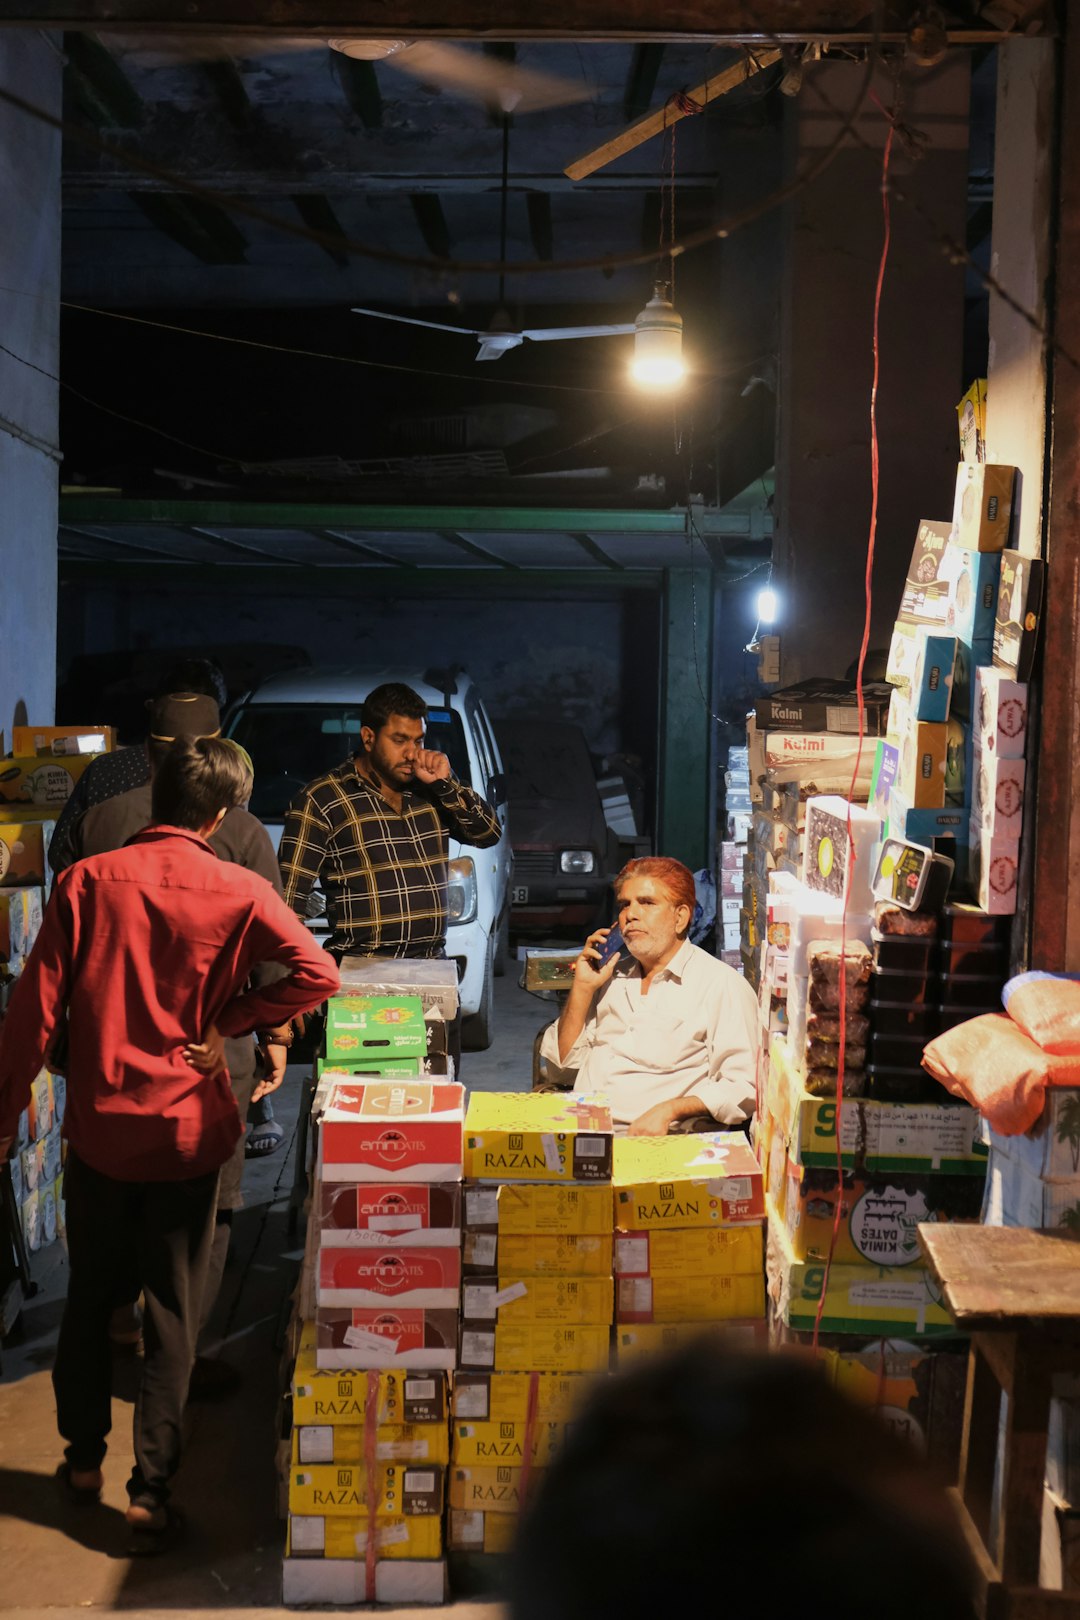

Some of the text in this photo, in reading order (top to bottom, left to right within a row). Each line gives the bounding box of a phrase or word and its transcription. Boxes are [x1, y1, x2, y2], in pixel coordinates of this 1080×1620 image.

[771, 708, 803, 721] Kalmi
[1006, 707, 1015, 730] AJWA
[783, 738, 825, 751] Kalmi
[48, 771, 69, 779] KIMIA
[1005, 786, 1013, 810] AJWA
[998, 864, 1007, 886] AJWA
[485, 1153, 547, 1169] RAZAN
[637, 1201, 700, 1220] RAZAN
[729, 1204, 737, 1216] 5
[861, 1229, 899, 1241] DATES
[860, 1240, 898, 1254] KIMIA
[314, 1400, 367, 1415] RAZA
[313, 1489, 367, 1505] RAZA
[472, 1485, 520, 1501] RAZA
